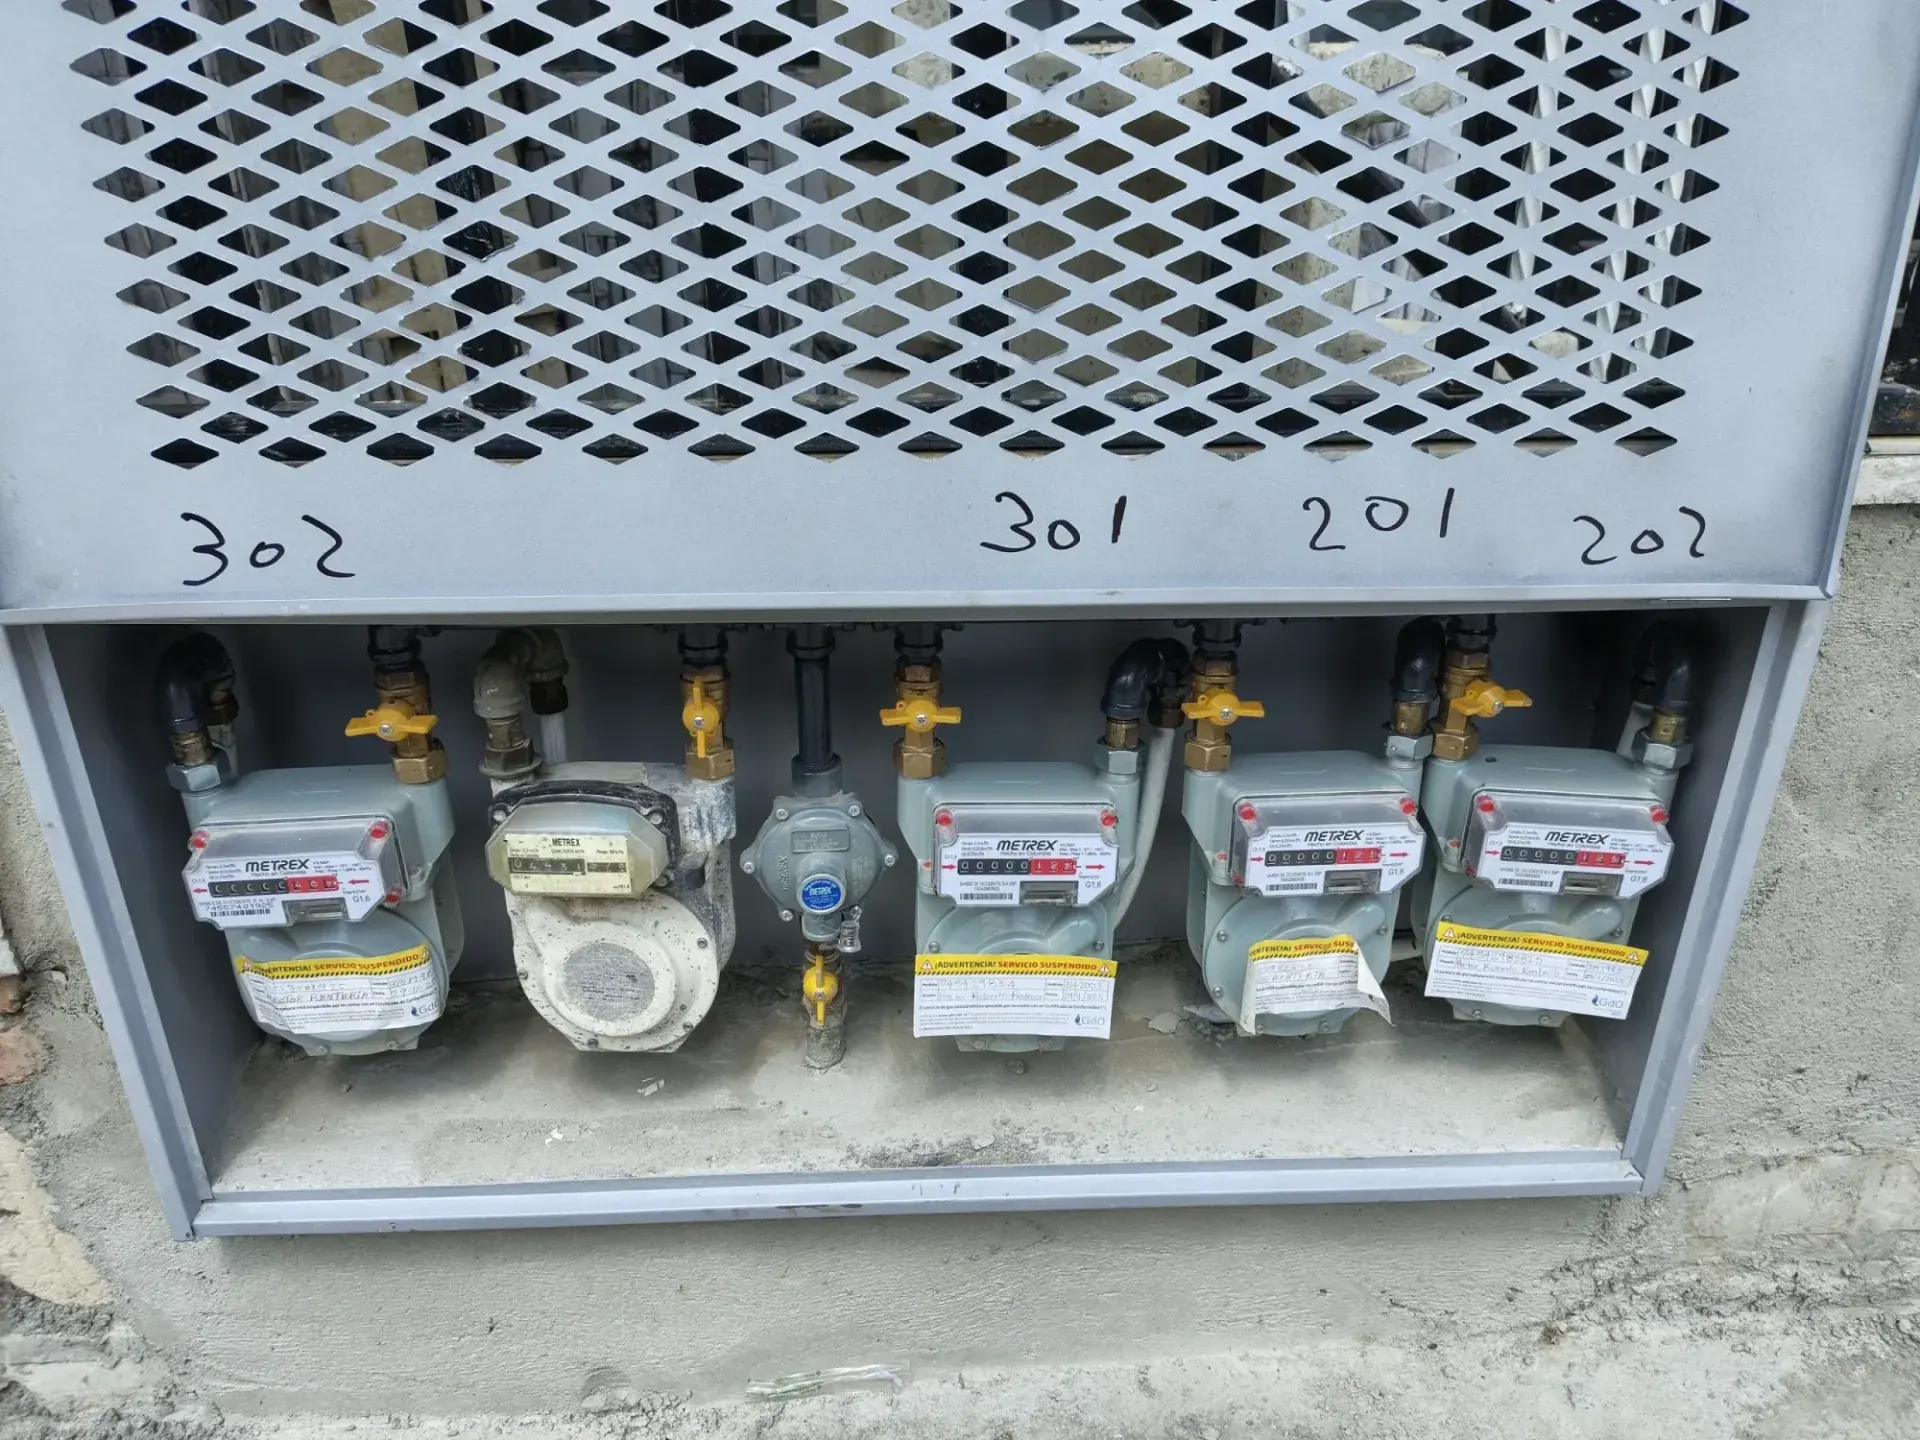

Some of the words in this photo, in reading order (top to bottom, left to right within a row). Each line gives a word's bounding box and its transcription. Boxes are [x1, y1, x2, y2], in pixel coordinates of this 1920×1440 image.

[980, 492, 1127, 552] 301
[1303, 488, 1455, 550] 201
[1574, 506, 1706, 565] 202
[181, 513, 355, 586] 302
[552, 838, 580, 847] METREX
[1304, 829, 1366, 842] METREX
[1544, 831, 1610, 845] METREX
[996, 839, 1058, 851] METREX
[246, 858, 310, 872] METREX
[1294, 943, 1332, 952] SERVICIO
[1457, 932, 1520, 943] ¡ADVERTENCIA!
[1522, 937, 1564, 948] SERVICIO
[1565, 942, 1626, 957] SUSPENDIDO
[314, 962, 357, 970] SERVICIO
[358, 954, 420, 970] SUSPENDIDO
[935, 961, 997, 970] ¡ADVERTENCIA!
[998, 961, 1038, 969] SERVICIO
[1040, 961, 1098, 971] SUSPENDIDO
[1599, 997, 1624, 1009] GdO
[1082, 1015, 1105, 1026] GdO
